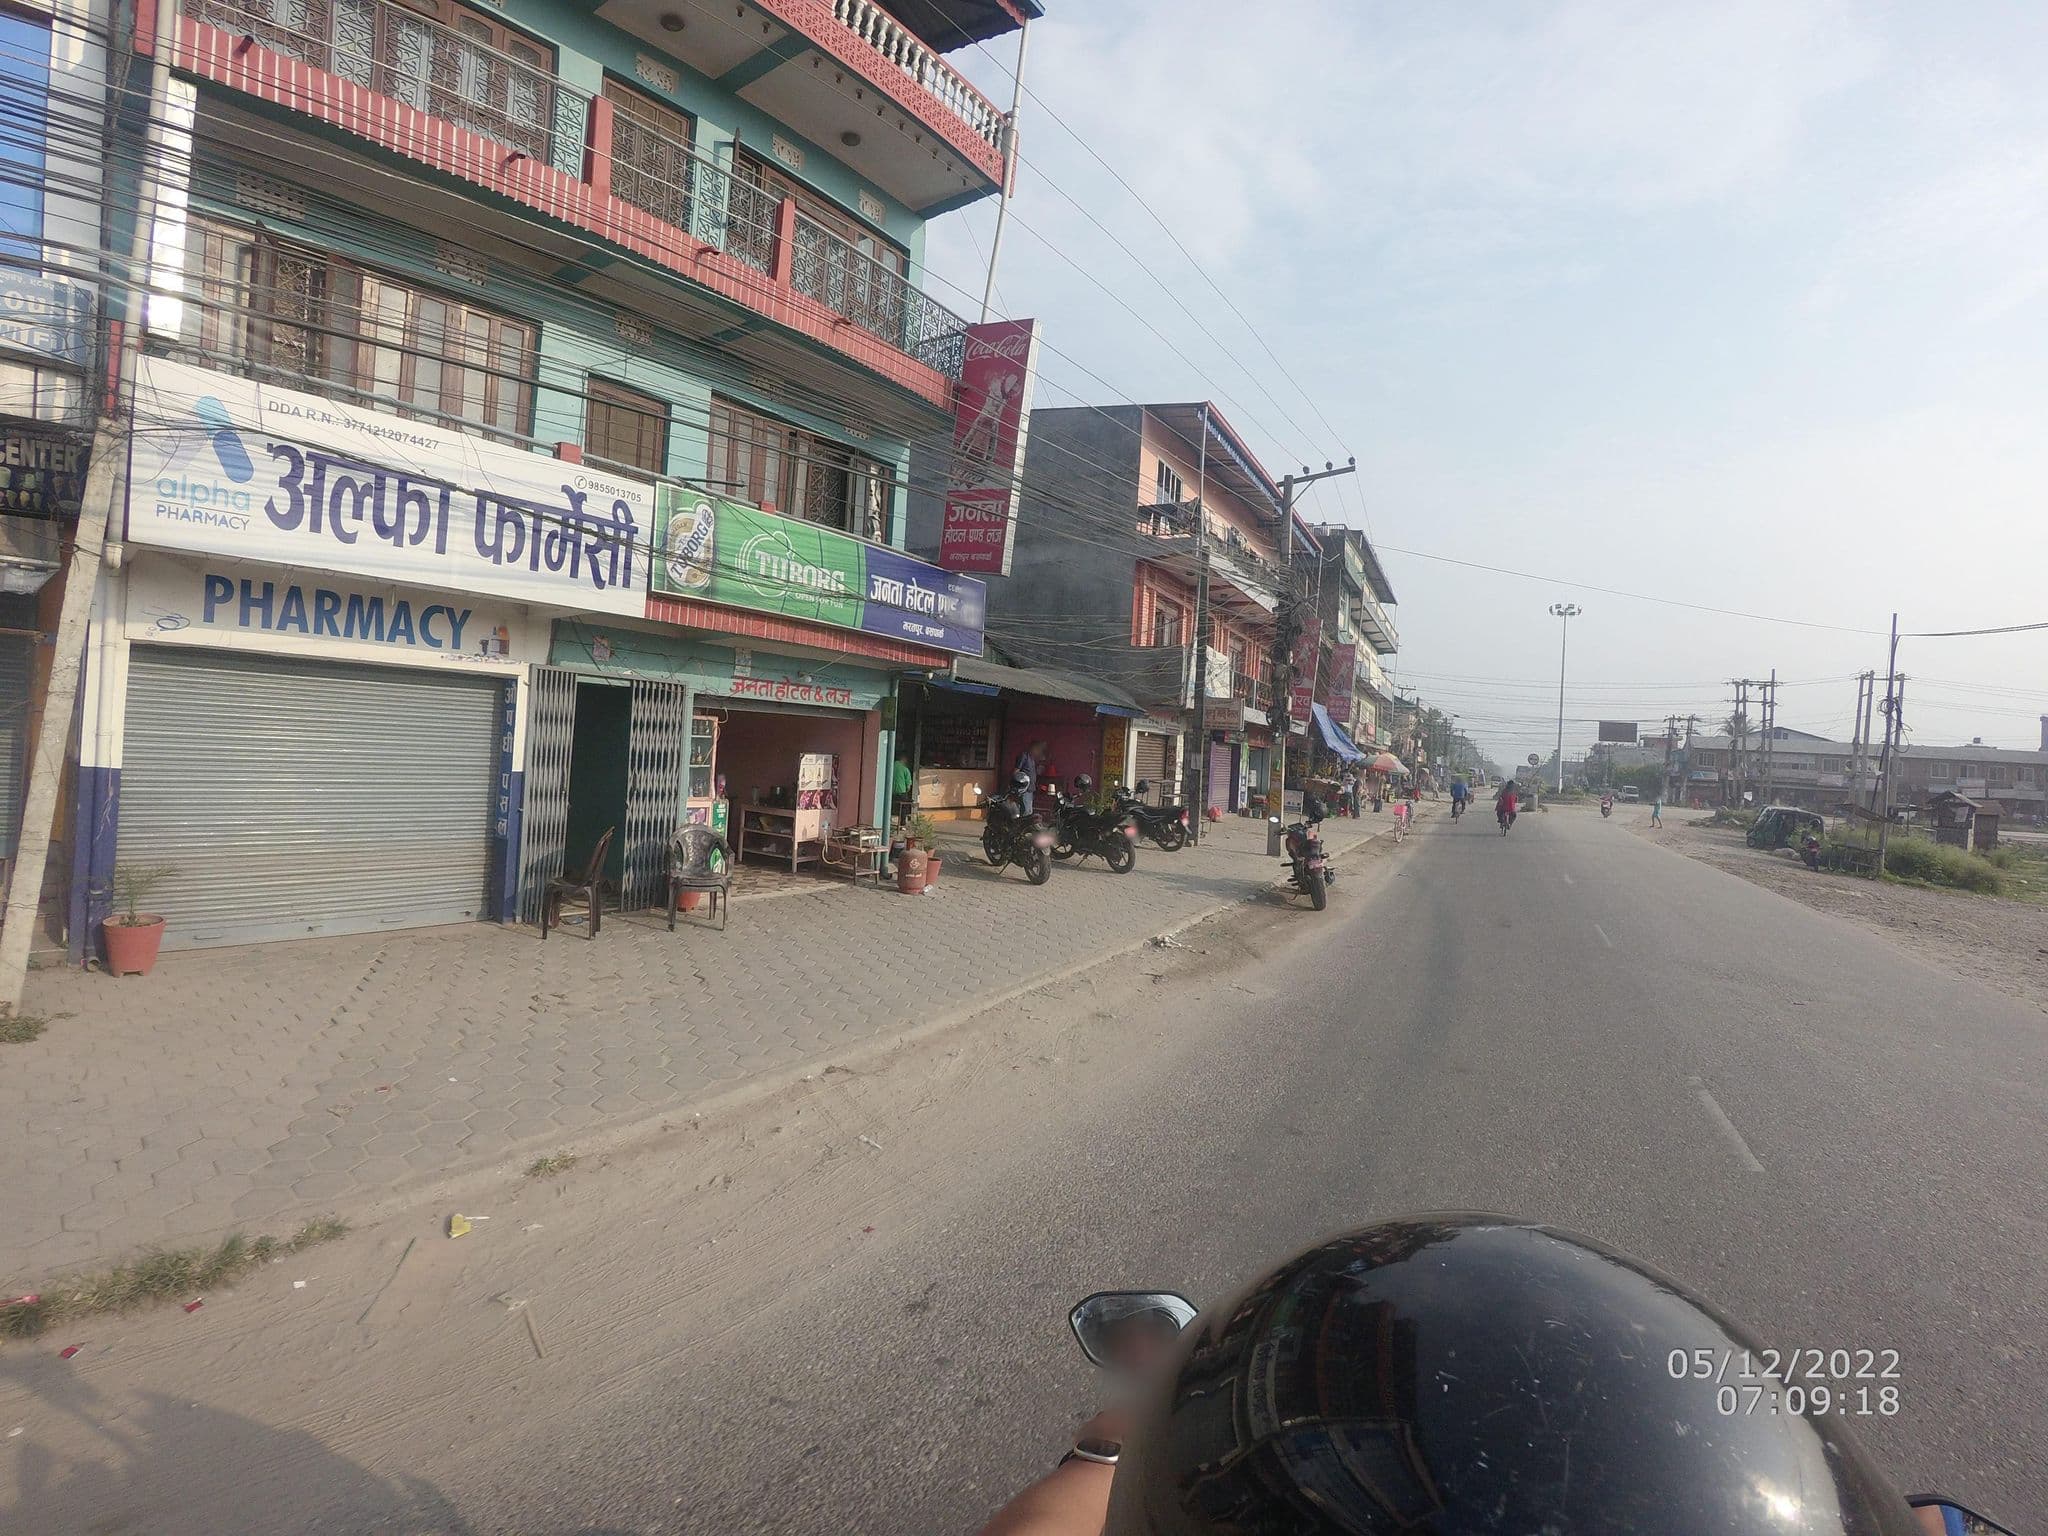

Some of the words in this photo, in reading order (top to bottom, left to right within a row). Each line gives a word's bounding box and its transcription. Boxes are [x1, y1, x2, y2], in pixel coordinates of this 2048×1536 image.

[268, 400, 302, 417] DDA
[156, 474, 251, 511] alpha
[264, 443, 450, 554] अल्फा
[587, 481, 642, 502] 9855013705
[156, 504, 250, 531] PHARMACY
[755, 550, 846, 593] TUBORG
[202, 574, 472, 650] PHARMACY
[775, 676, 813, 702] होटल
[814, 687, 824, 702] &
